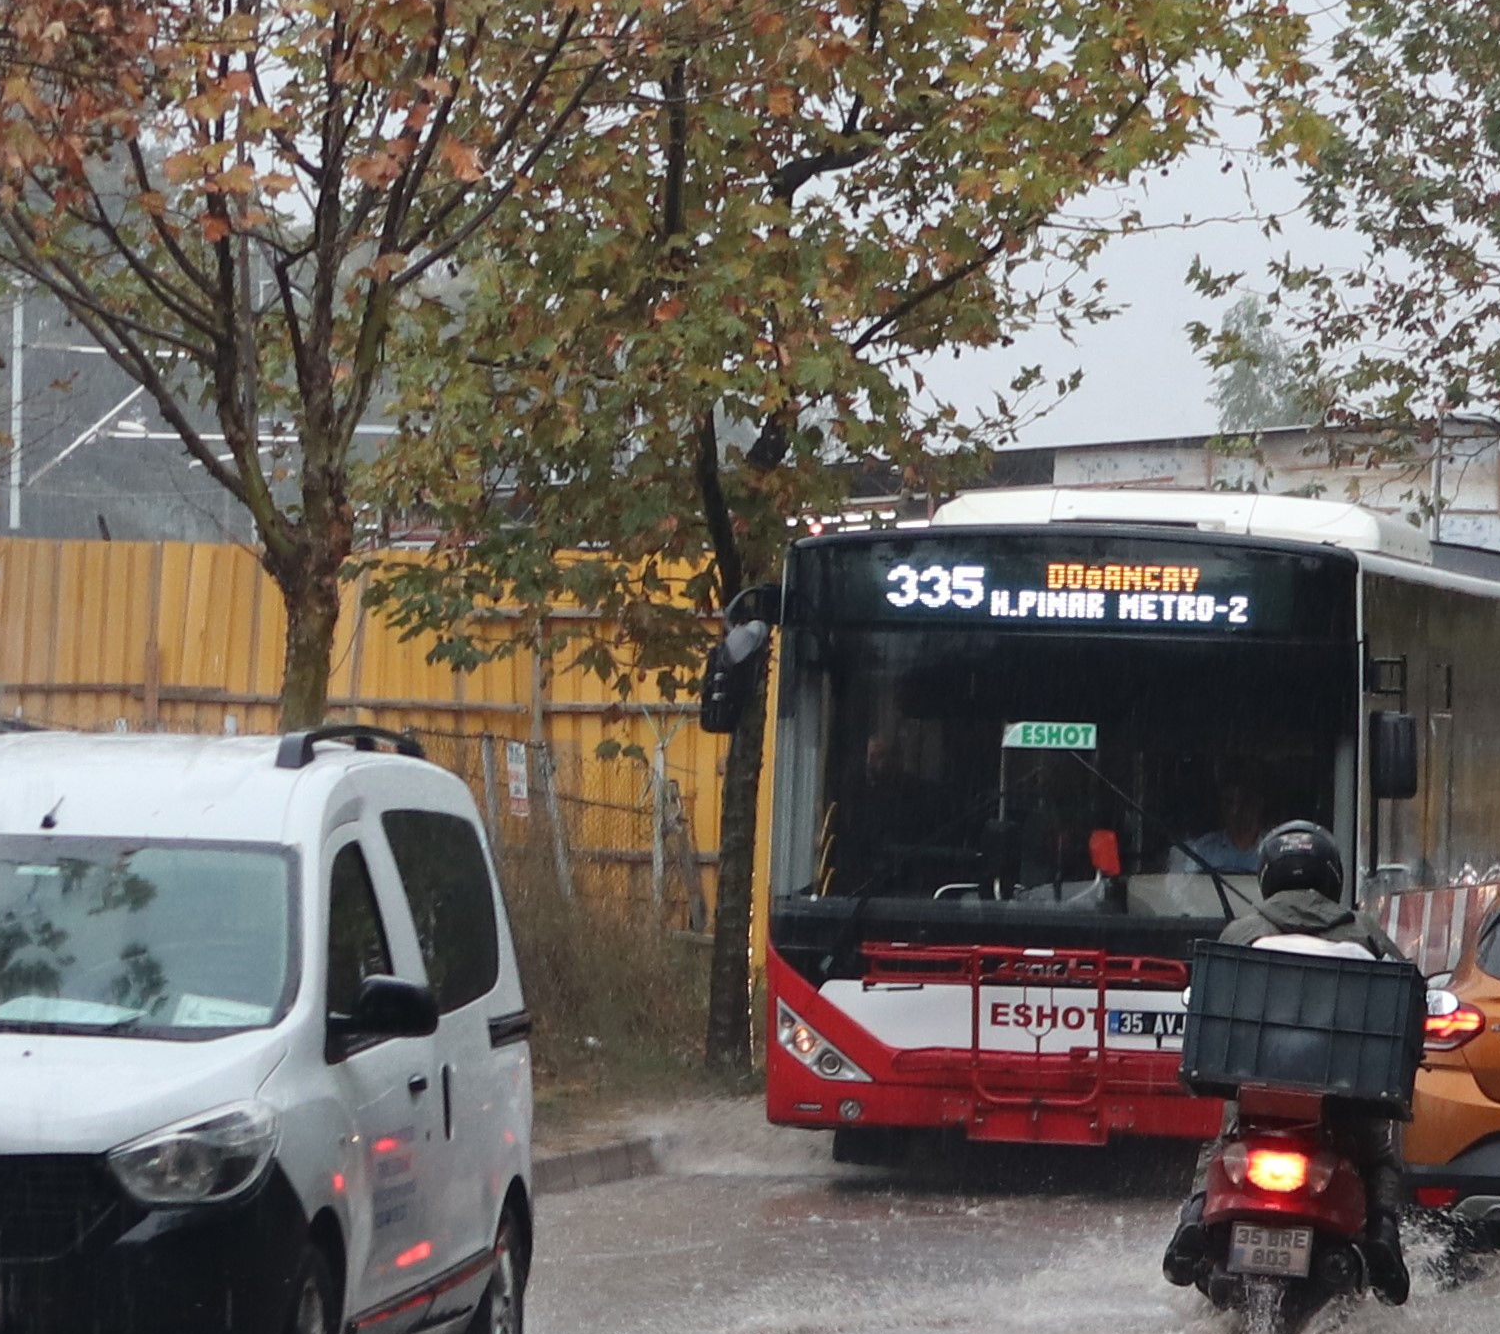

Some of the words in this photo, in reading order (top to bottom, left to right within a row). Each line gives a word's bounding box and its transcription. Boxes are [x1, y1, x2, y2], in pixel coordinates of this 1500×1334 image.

[886, 565, 984, 608] 335
[1047, 564, 1199, 592] DOĞANÇAY
[990, 590, 1105, 618] H.PINAR
[1118, 593, 1249, 623] METRO-2
[1021, 725, 1092, 746] ESHOT
[990, 1002, 1108, 1031] ESHOT
[1119, 1013, 1143, 1033] 35
[1237, 1229, 1262, 1245] 35
